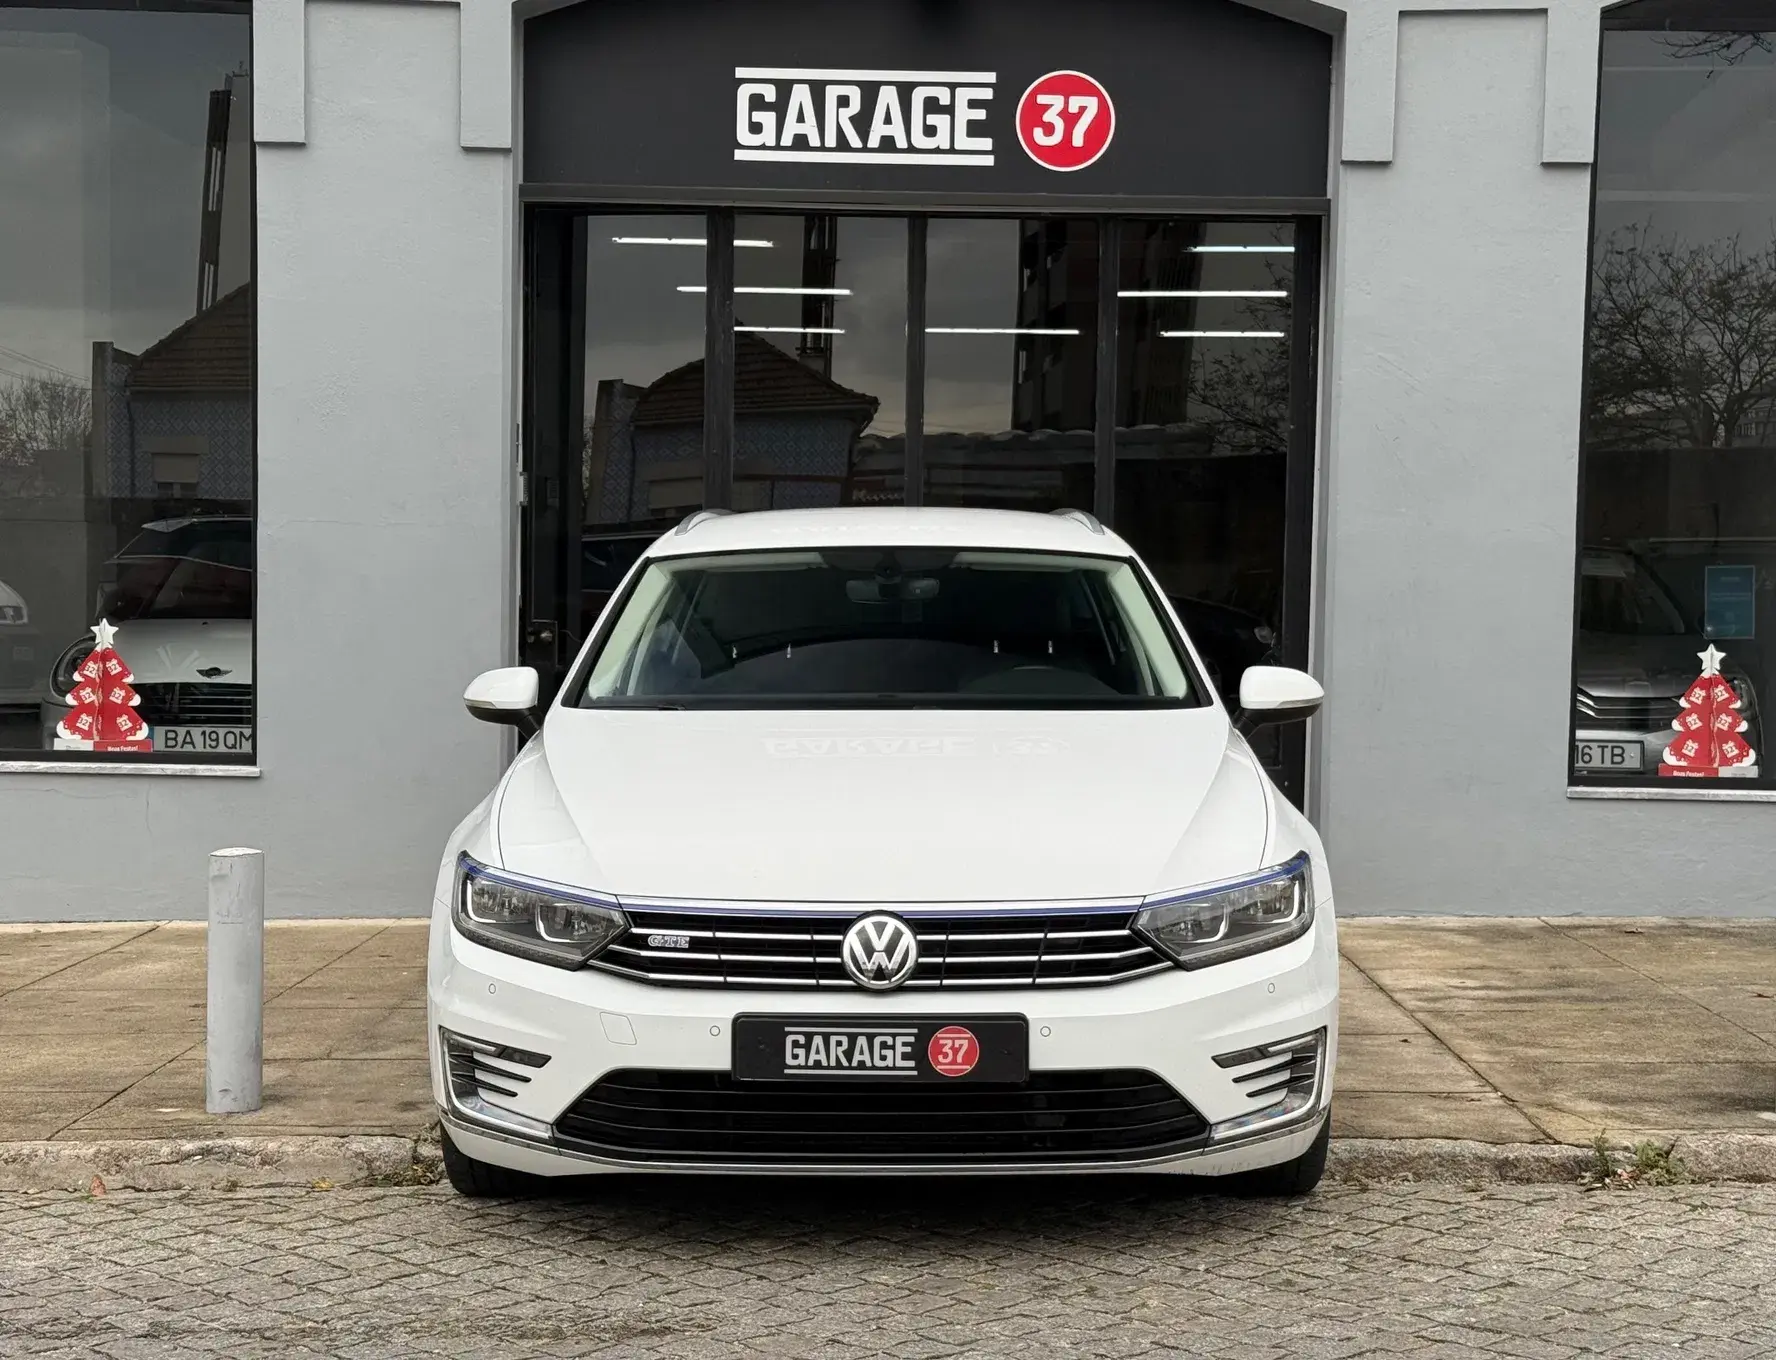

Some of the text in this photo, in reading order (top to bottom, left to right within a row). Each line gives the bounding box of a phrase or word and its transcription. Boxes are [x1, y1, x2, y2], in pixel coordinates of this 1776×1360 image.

[736, 83, 1099, 151] GARAGE 37
[164, 729, 196, 749] BA
[200, 730, 220, 750] 19
[1575, 744, 1626, 765] 16 TB
[647, 934, 690, 949] GTE
[844, 916, 915, 987] VW
[785, 1034, 969, 1068] GARAGE 37
